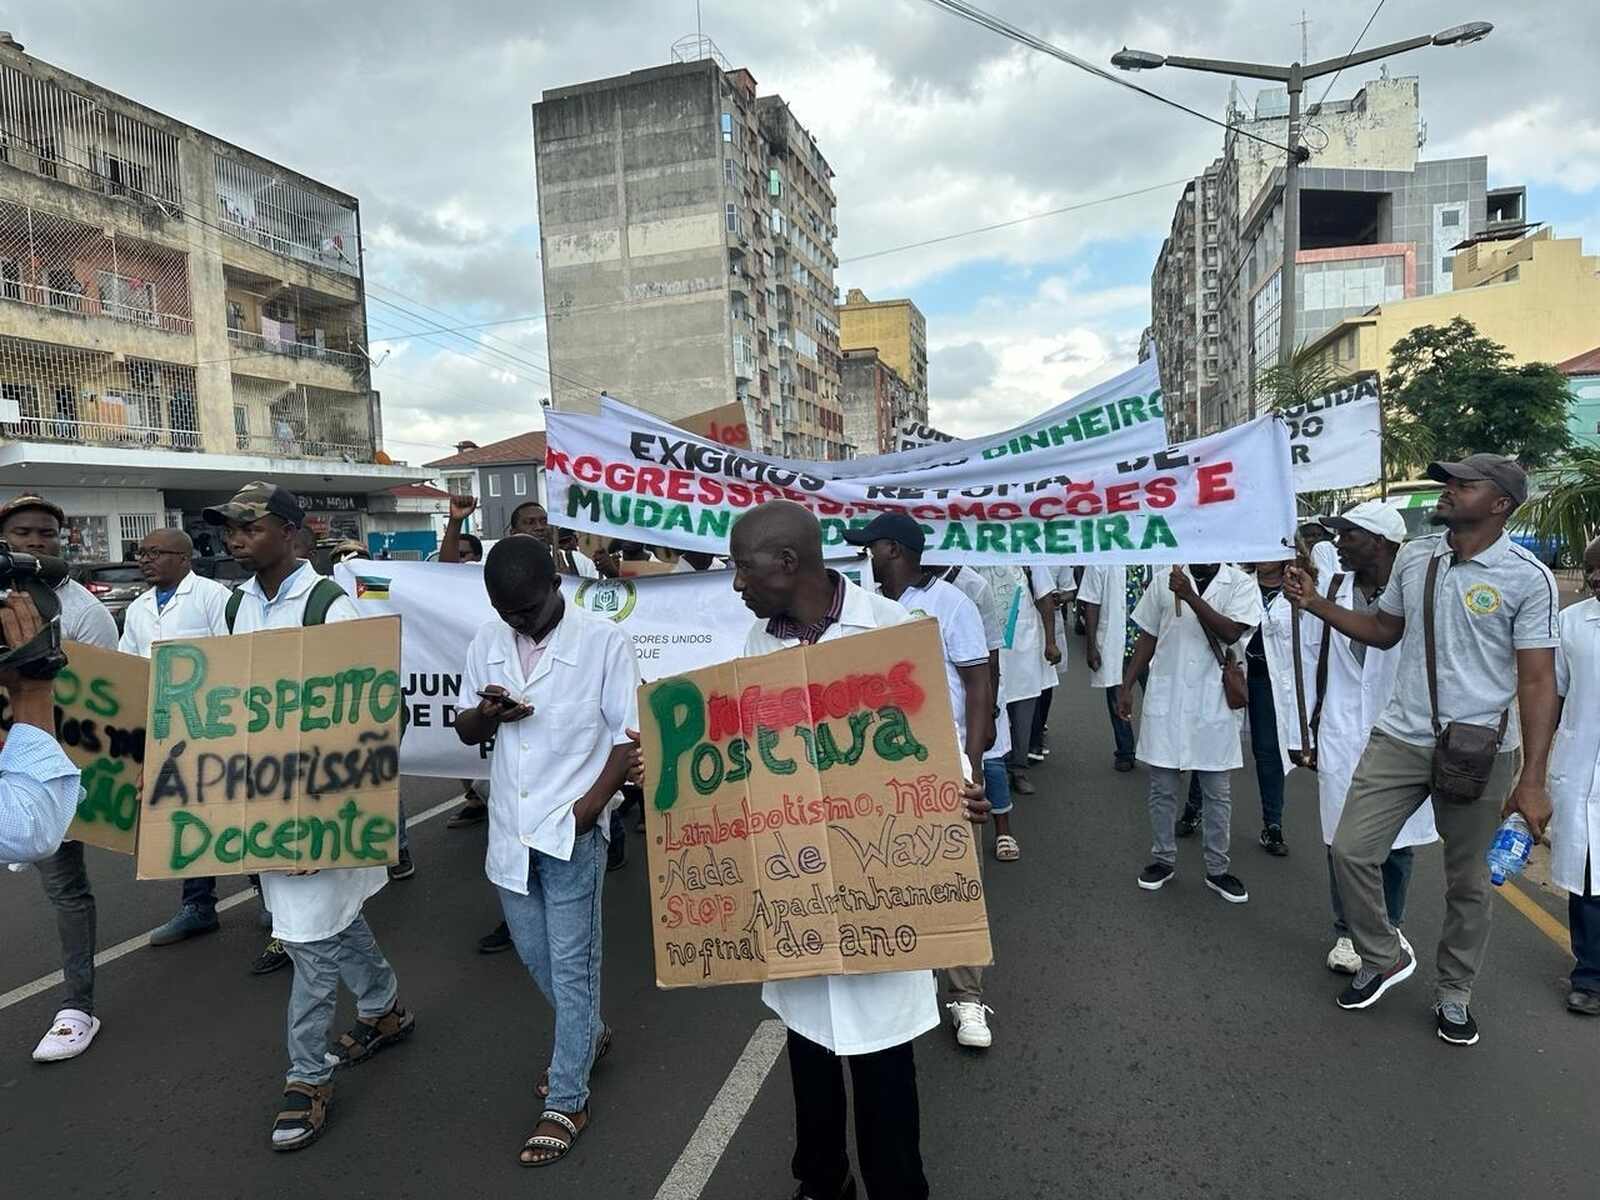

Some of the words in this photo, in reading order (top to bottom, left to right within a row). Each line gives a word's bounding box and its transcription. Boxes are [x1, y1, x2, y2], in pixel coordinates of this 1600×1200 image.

[630, 431, 826, 491] EXIGIMOS
[1197, 461, 1236, 505] E
[671, 633, 713, 644] UNIDOS
[886, 774, 960, 819] não
[169, 799, 397, 870] Docente
[660, 845, 744, 900] Nada
[764, 831, 826, 881] de
[827, 814, 970, 873] Ways
[665, 892, 737, 932] Stop
[776, 920, 825, 960] de
[838, 923, 918, 957] ano
